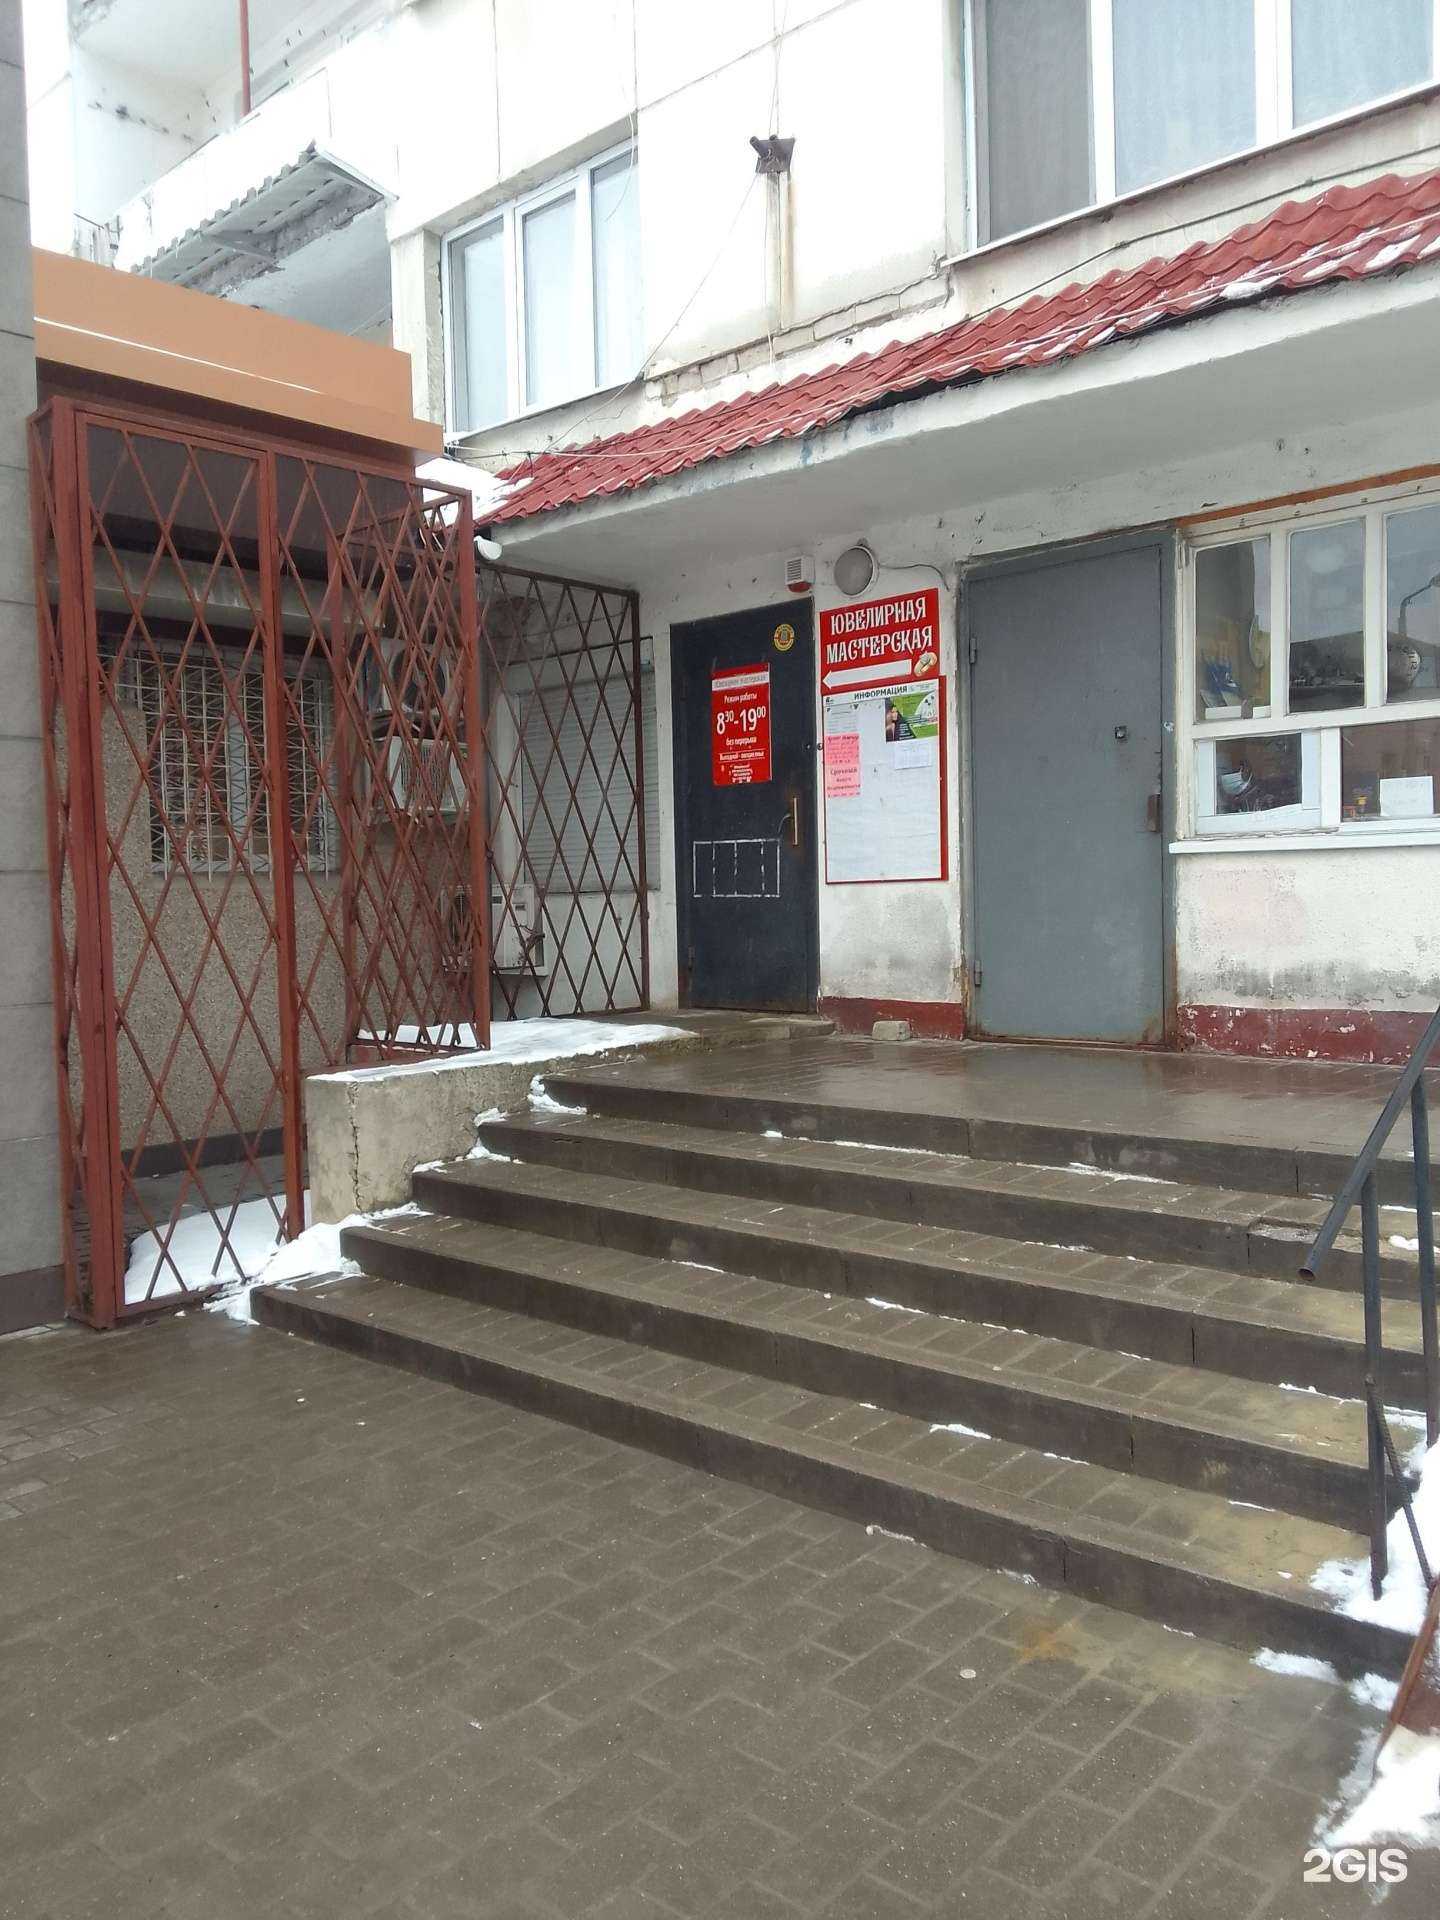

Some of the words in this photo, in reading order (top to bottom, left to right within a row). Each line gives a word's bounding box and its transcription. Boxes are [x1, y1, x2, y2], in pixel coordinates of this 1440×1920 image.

[831, 596, 926, 636] ЮВЕЛИРНАЯ
[826, 625, 933, 665] МАСТЕРСКАЯ
[854, 685, 908, 701] ИНФОРМАЦИЯ
